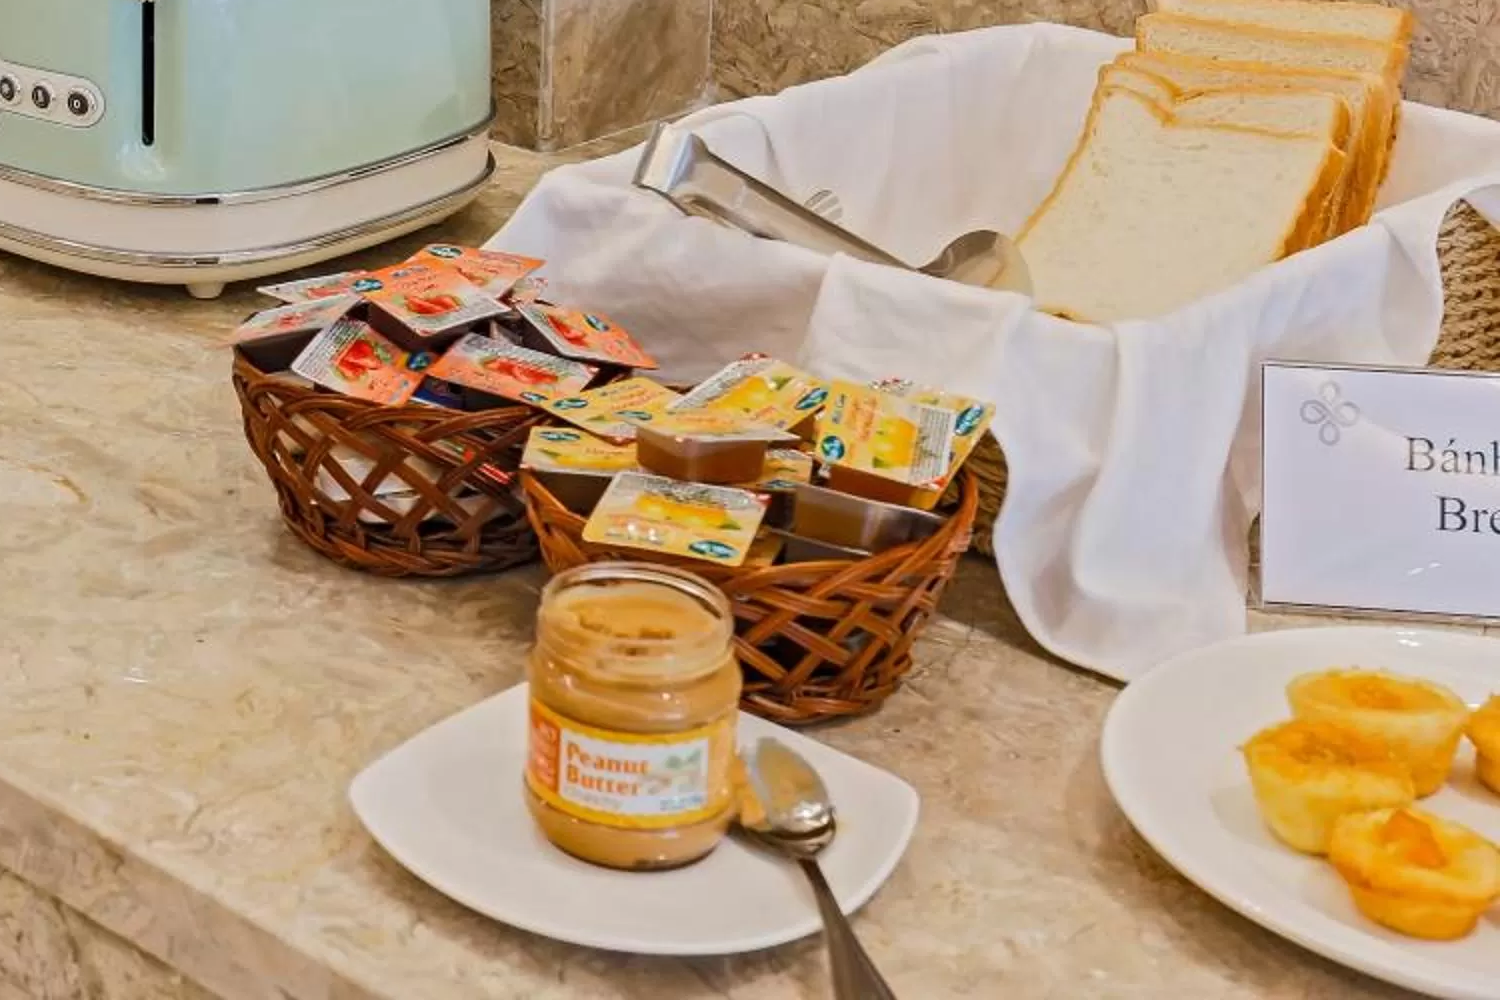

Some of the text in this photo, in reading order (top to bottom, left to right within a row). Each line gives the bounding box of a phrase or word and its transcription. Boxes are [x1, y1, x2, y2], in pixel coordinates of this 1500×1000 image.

[1435, 495, 1500, 534] Bre
[566, 742, 649, 775] Peanut
[567, 764, 638, 796] Butter
